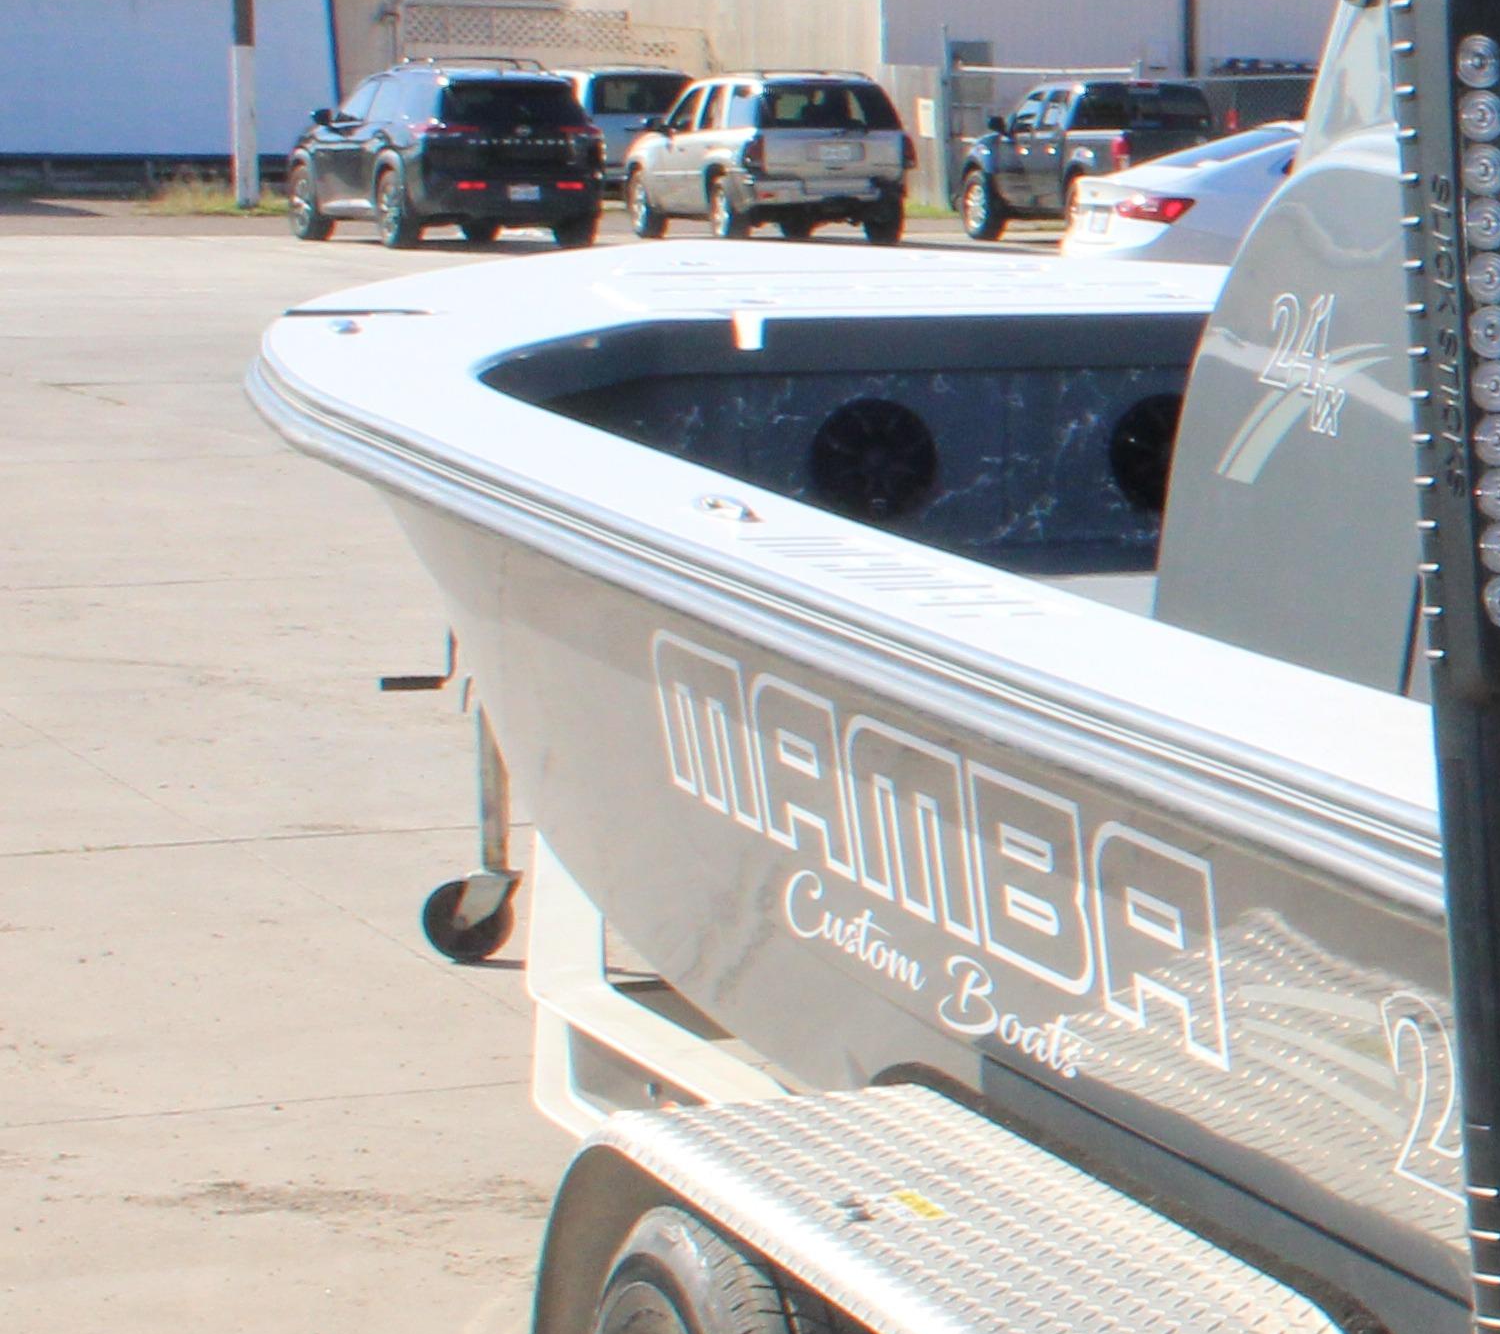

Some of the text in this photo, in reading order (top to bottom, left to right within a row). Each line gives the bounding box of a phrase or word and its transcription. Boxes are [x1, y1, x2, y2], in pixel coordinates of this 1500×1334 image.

[1258, 292, 1336, 396] 24
[1430, 171, 1467, 499] SLICK STICKS
[651, 628, 1232, 1074] MAMBA
[783, 868, 1082, 1079] Custom Boats
